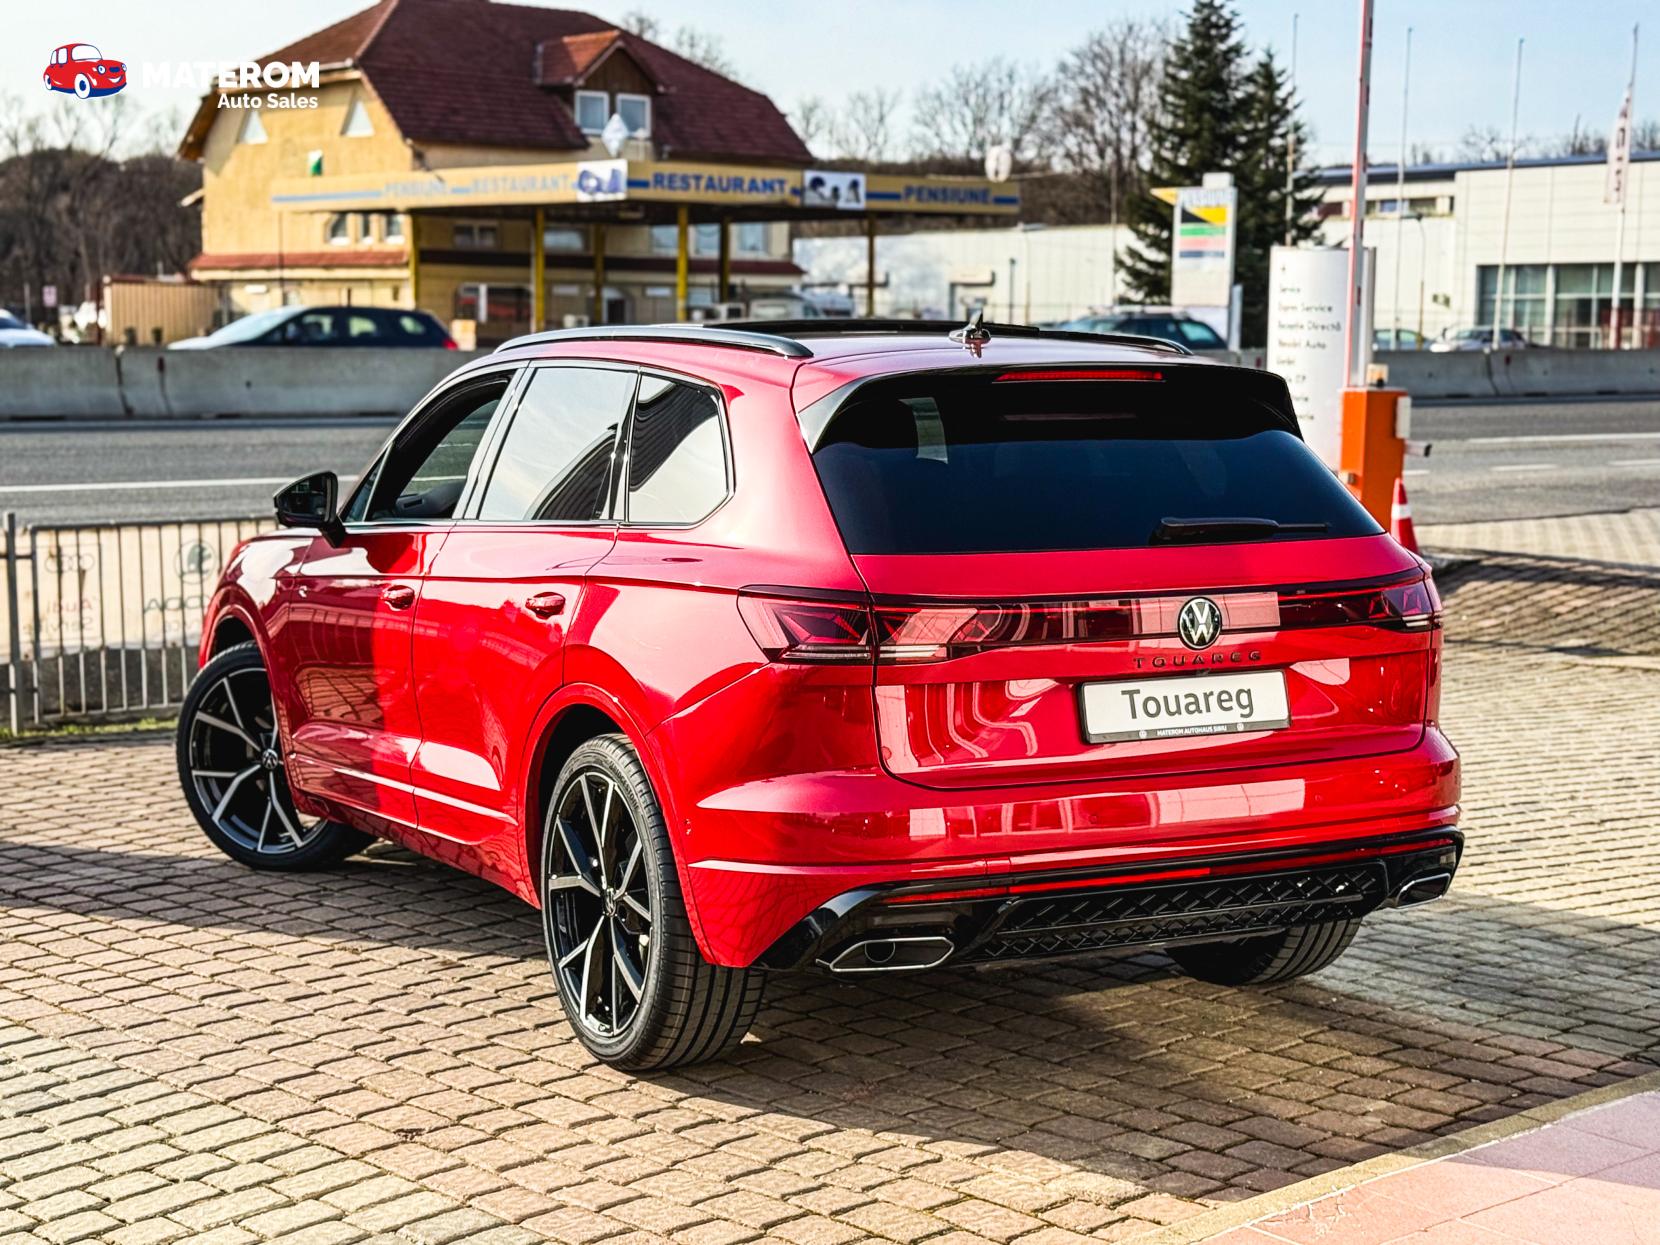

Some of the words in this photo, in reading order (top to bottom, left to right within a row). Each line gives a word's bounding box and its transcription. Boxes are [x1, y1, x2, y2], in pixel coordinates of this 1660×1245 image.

[652, 172, 788, 195] RESTAURANT
[904, 186, 993, 204] PENSIUNE
[1133, 650, 1262, 669] TOUAREG
[1121, 687, 1253, 719] Touareg
